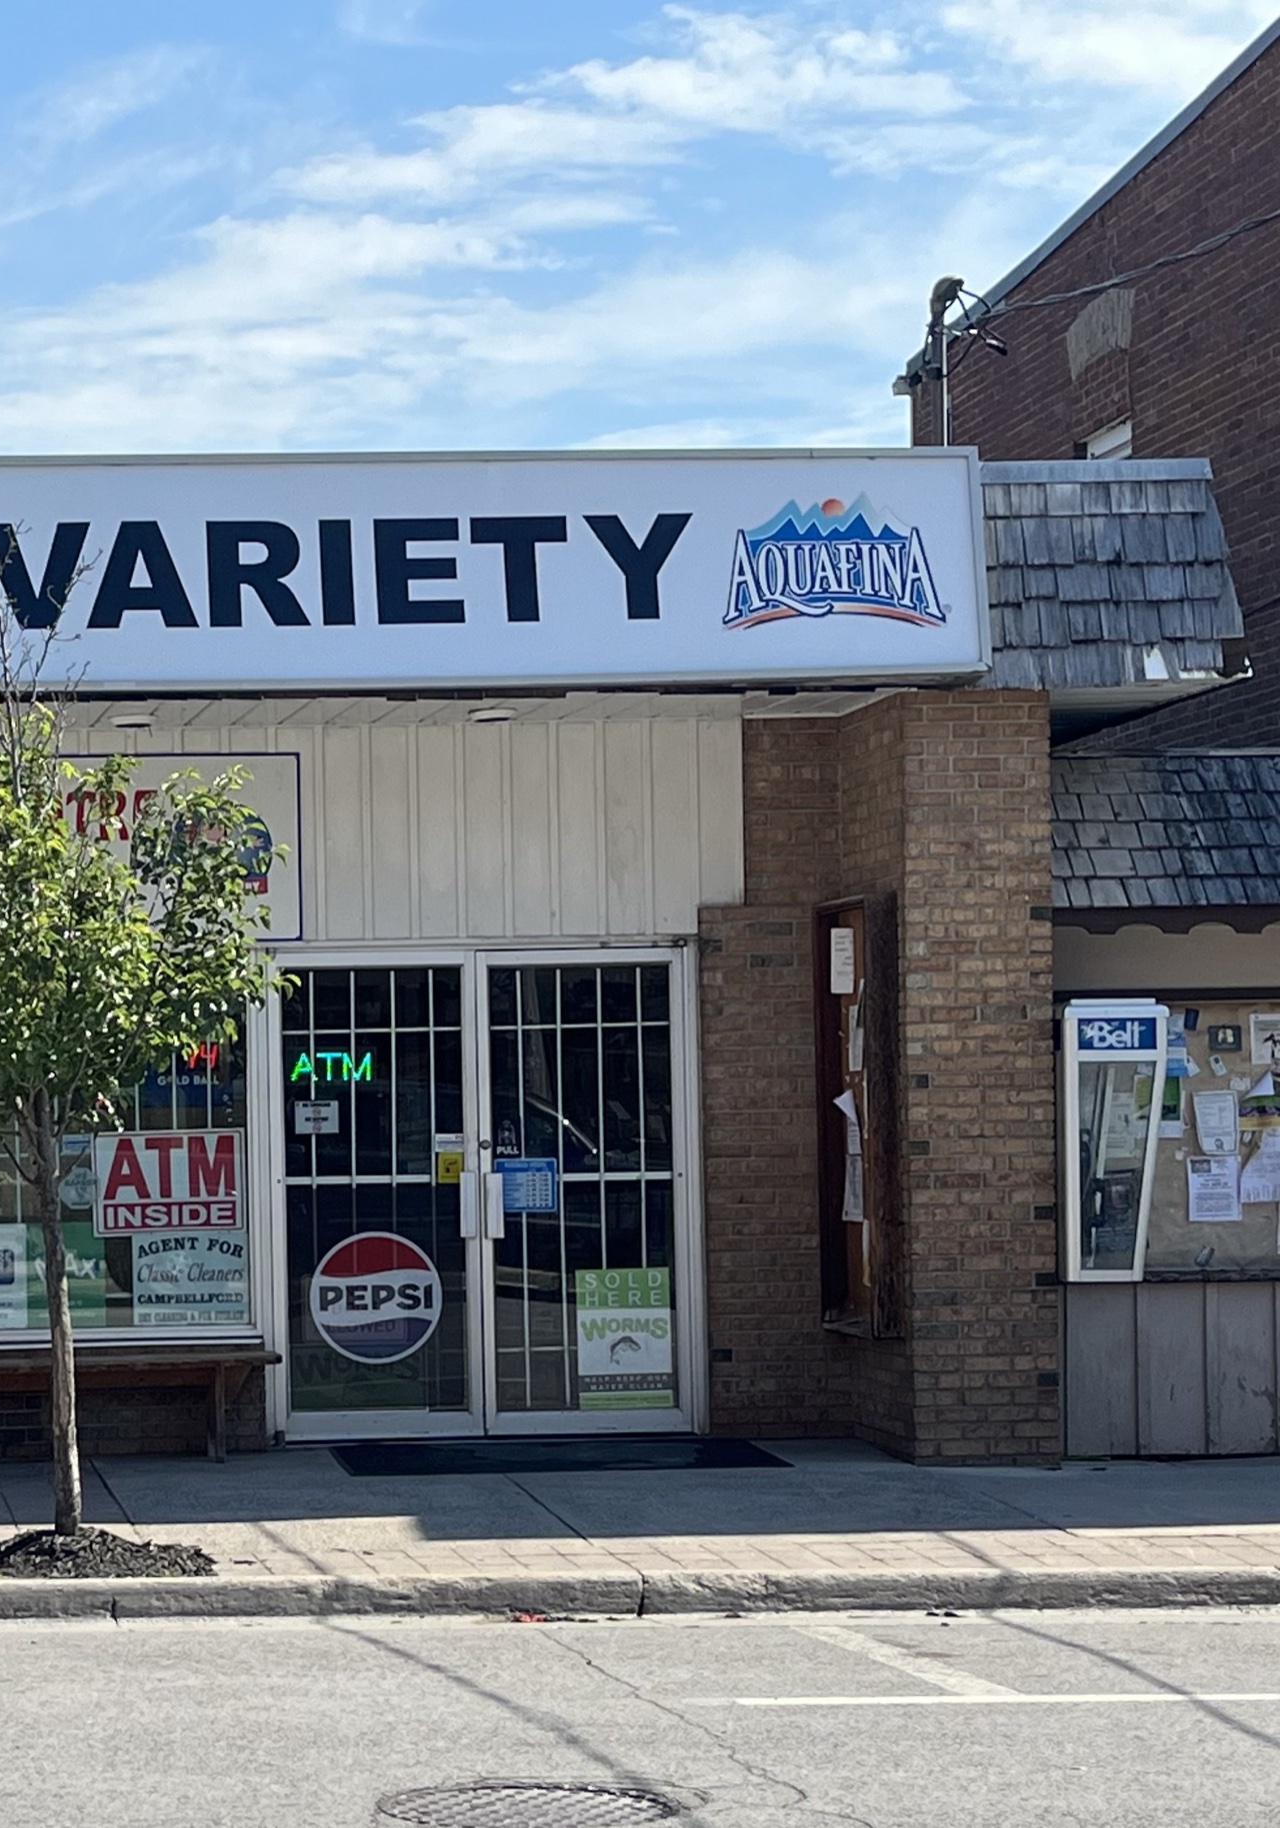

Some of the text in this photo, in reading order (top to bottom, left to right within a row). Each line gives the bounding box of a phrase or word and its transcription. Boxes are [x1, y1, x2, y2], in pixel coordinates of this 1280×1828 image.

[722, 526, 947, 624] AQUAFINA
[1092, 1020, 1140, 1048] Bell
[290, 1052, 371, 1081] ATM
[496, 1145, 519, 1155] PULL
[103, 1135, 236, 1200] ATM
[106, 1203, 234, 1228] INSIDE
[137, 1236, 244, 1259] AGENT FOR
[137, 1262, 244, 1283] Classic Cleaners
[585, 1271, 661, 1289] SOLD
[319, 1283, 433, 1311] PEPSI
[585, 1290, 662, 1307] HERE
[580, 1317, 669, 1341] WORMS
